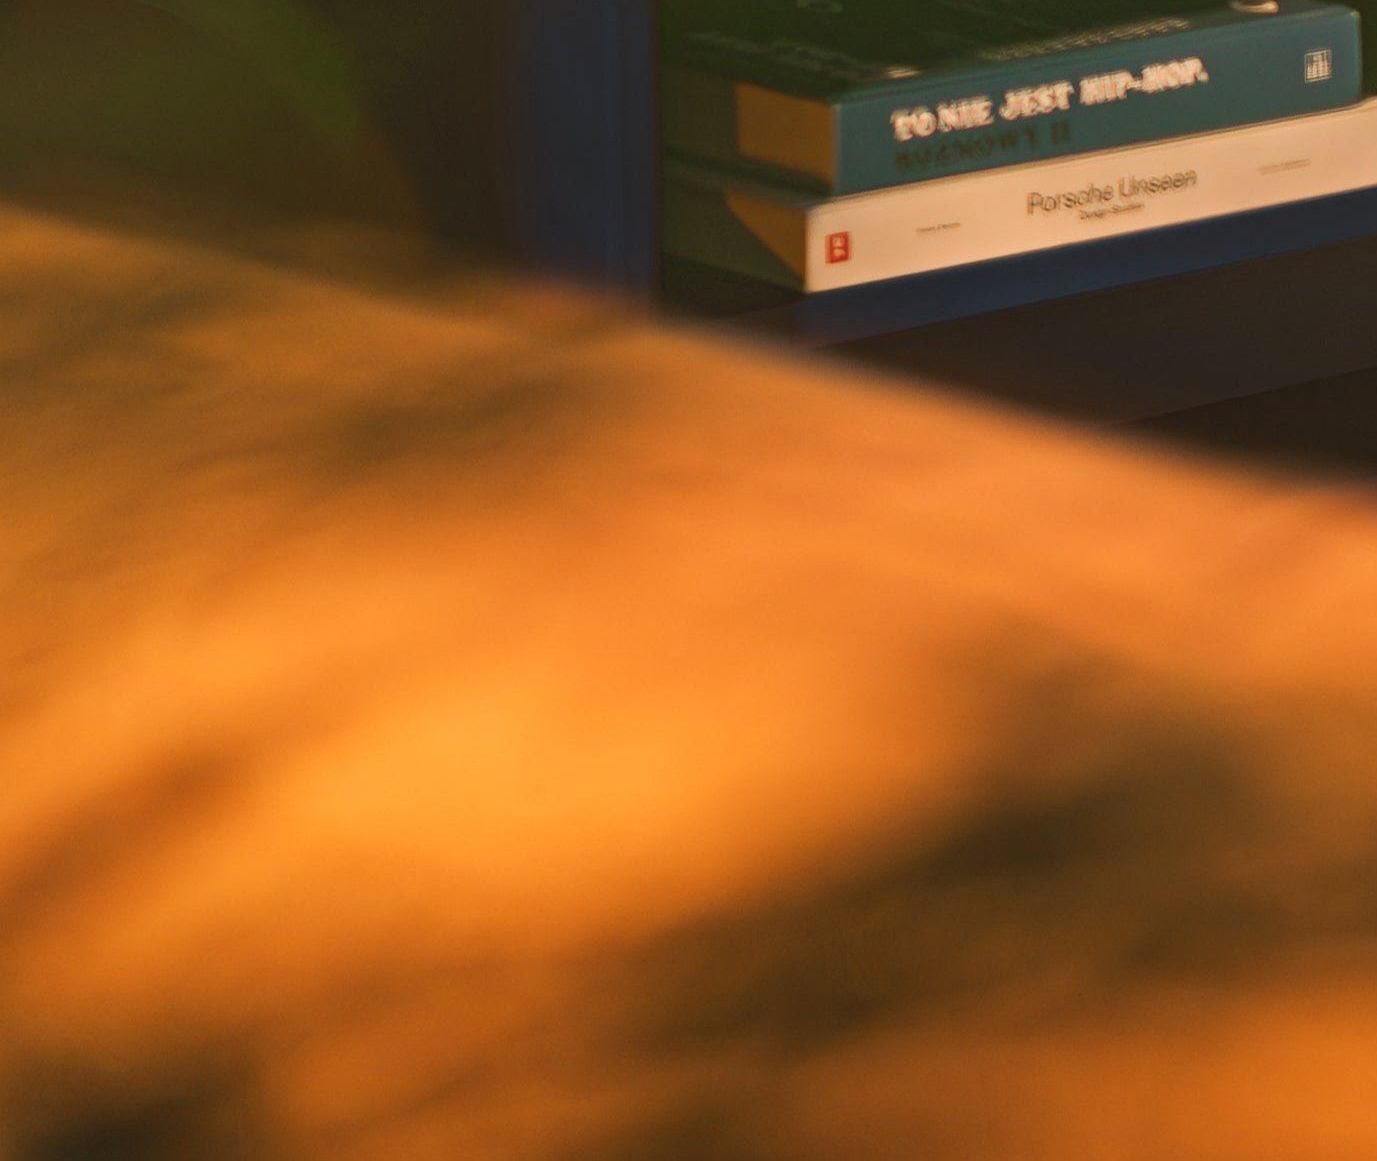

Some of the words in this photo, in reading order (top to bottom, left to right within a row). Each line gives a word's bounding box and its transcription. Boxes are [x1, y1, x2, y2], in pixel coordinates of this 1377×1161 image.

[889, 106, 937, 142] TO
[937, 95, 995, 133] NIE
[998, 78, 1075, 121] JEST
[1026, 183, 1115, 214] Porsche
[1117, 169, 1198, 200] Unseen
